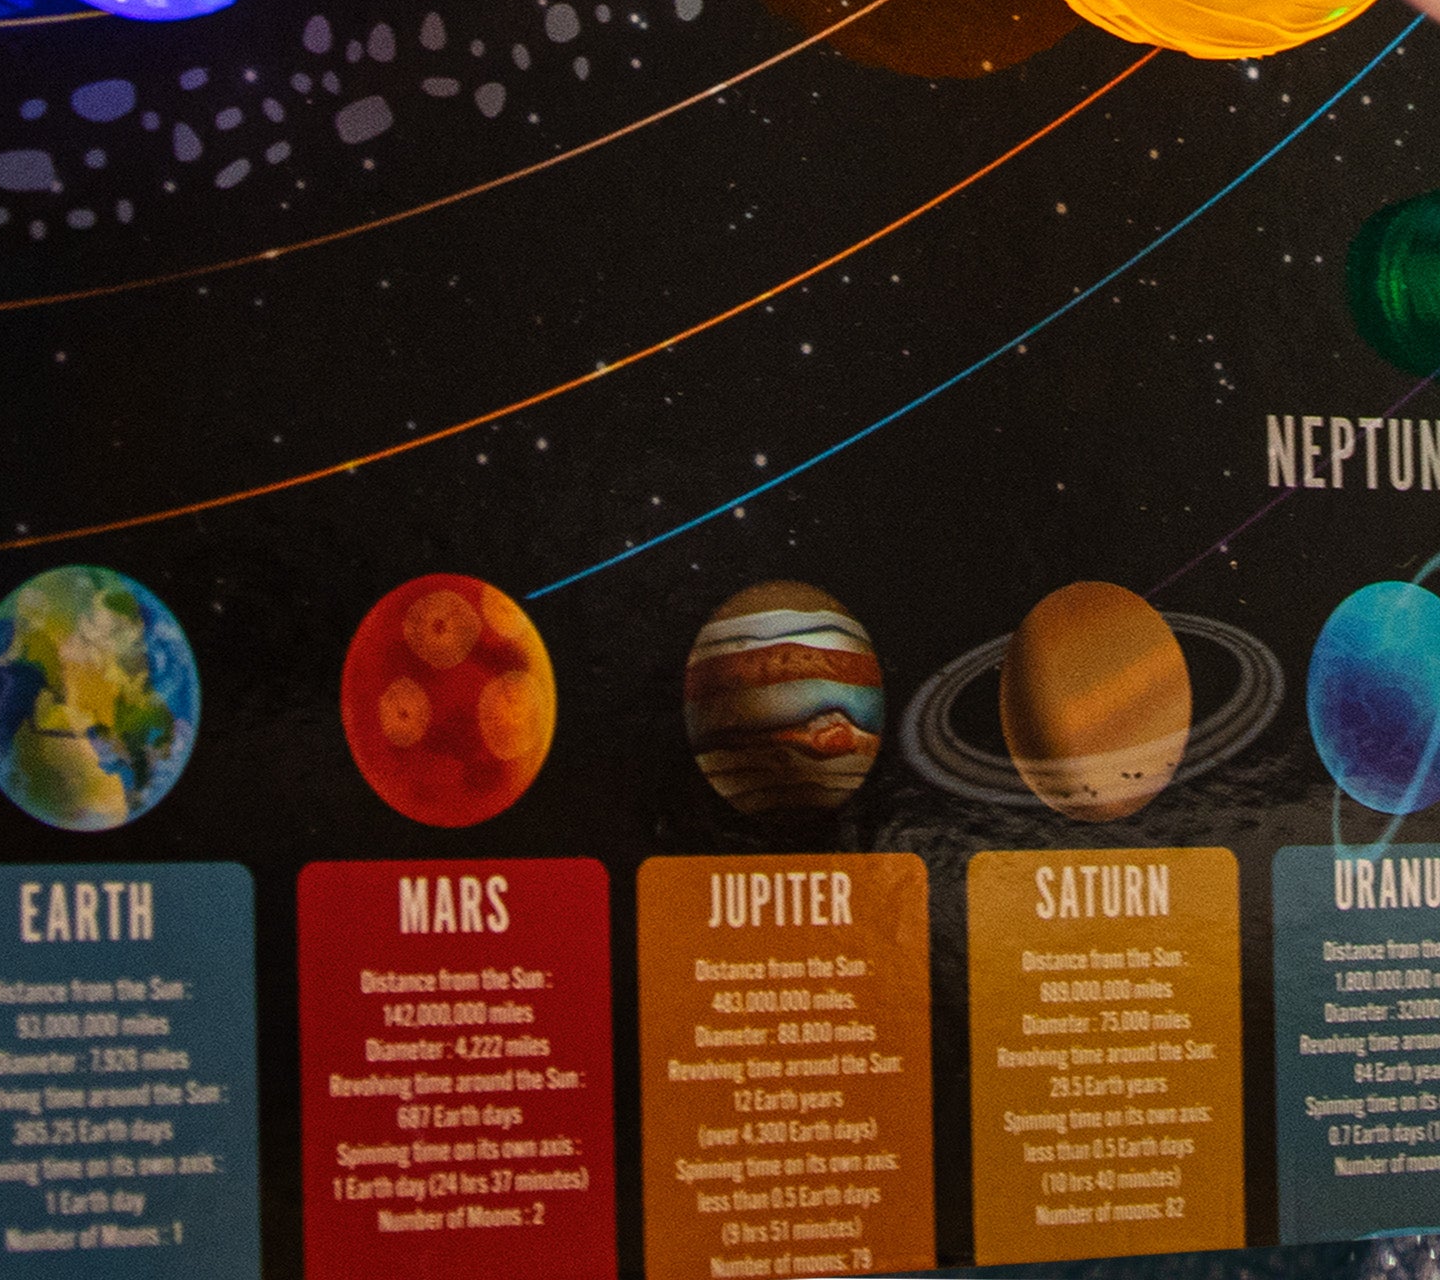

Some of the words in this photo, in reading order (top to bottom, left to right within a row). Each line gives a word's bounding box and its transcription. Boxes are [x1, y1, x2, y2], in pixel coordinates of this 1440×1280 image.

[399, 875, 509, 933] MARS
[709, 871, 853, 928] JUPITER
[1035, 864, 1169, 920] SATURN
[20, 882, 154, 942] EARTH
[1022, 950, 1087, 972] Distance
[1089, 949, 1124, 969] from
[1126, 948, 1151, 968] the
[1323, 941, 1384, 961] Distance
[1386, 939, 1419, 959] from
[361, 970, 436, 994] Distance
[438, 969, 479, 991] from
[481, 968, 509, 990] the
[695, 959, 765, 981] Distance
[767, 958, 805, 978] from
[807, 957, 833, 978] the
[488, 1001, 534, 1023] miles
[1152, 1009, 1191, 1029] miles
[834, 1021, 876, 1041] miles
[504, 1035, 550, 1056] miles
[1374, 1062, 1412, 1082] Earth
[329, 1074, 411, 1101] Revolving
[413, 1073, 453, 1094] time
[455, 1070, 513, 1093] around
[515, 1069, 544, 1090] the
[1084, 1075, 1124, 1096] Earth
[1126, 1077, 1168, 1098] years
[753, 1089, 797, 1111] Earth
[799, 1091, 844, 1113] years
[433, 1105, 480, 1128] Earth
[482, 1105, 522, 1129] days
[788, 1120, 831, 1142] Earth
[833, 1118, 877, 1143] days)
[1352, 1124, 1390, 1145] Earth
[1392, 1123, 1425, 1145] days
[337, 1143, 410, 1169] Spinning
[412, 1141, 451, 1163] time
[453, 1143, 475, 1161] on
[476, 1139, 499, 1159] its
[501, 1140, 537, 1158] own
[1024, 1143, 1054, 1162] less
[1056, 1141, 1090, 1161] than
[1117, 1136, 1157, 1158] Earth
[1159, 1136, 1194, 1159] days
[1334, 1156, 1387, 1175] Number
[1389, 1153, 1404, 1173] of
[346, 1176, 393, 1200] Earth
[395, 1176, 426, 1201] day
[460, 1173, 489, 1194] hrs
[515, 1167, 589, 1191] minutes)
[1068, 1172, 1093, 1191] hrs
[1117, 1165, 1181, 1188] minutes)
[697, 1192, 730, 1213] less
[732, 1190, 769, 1210] than
[798, 1185, 841, 1207] Earth
[843, 1184, 881, 1208] days
[378, 1209, 443, 1232] Number
[445, 1206, 464, 1229] of
[1036, 1205, 1092, 1225] Number
[1094, 1201, 1110, 1222] of
[741, 1223, 768, 1242] hrs
[793, 1216, 862, 1240] minutes)
[712, 1256, 771, 1277] Number
[774, 1252, 790, 1275] of
